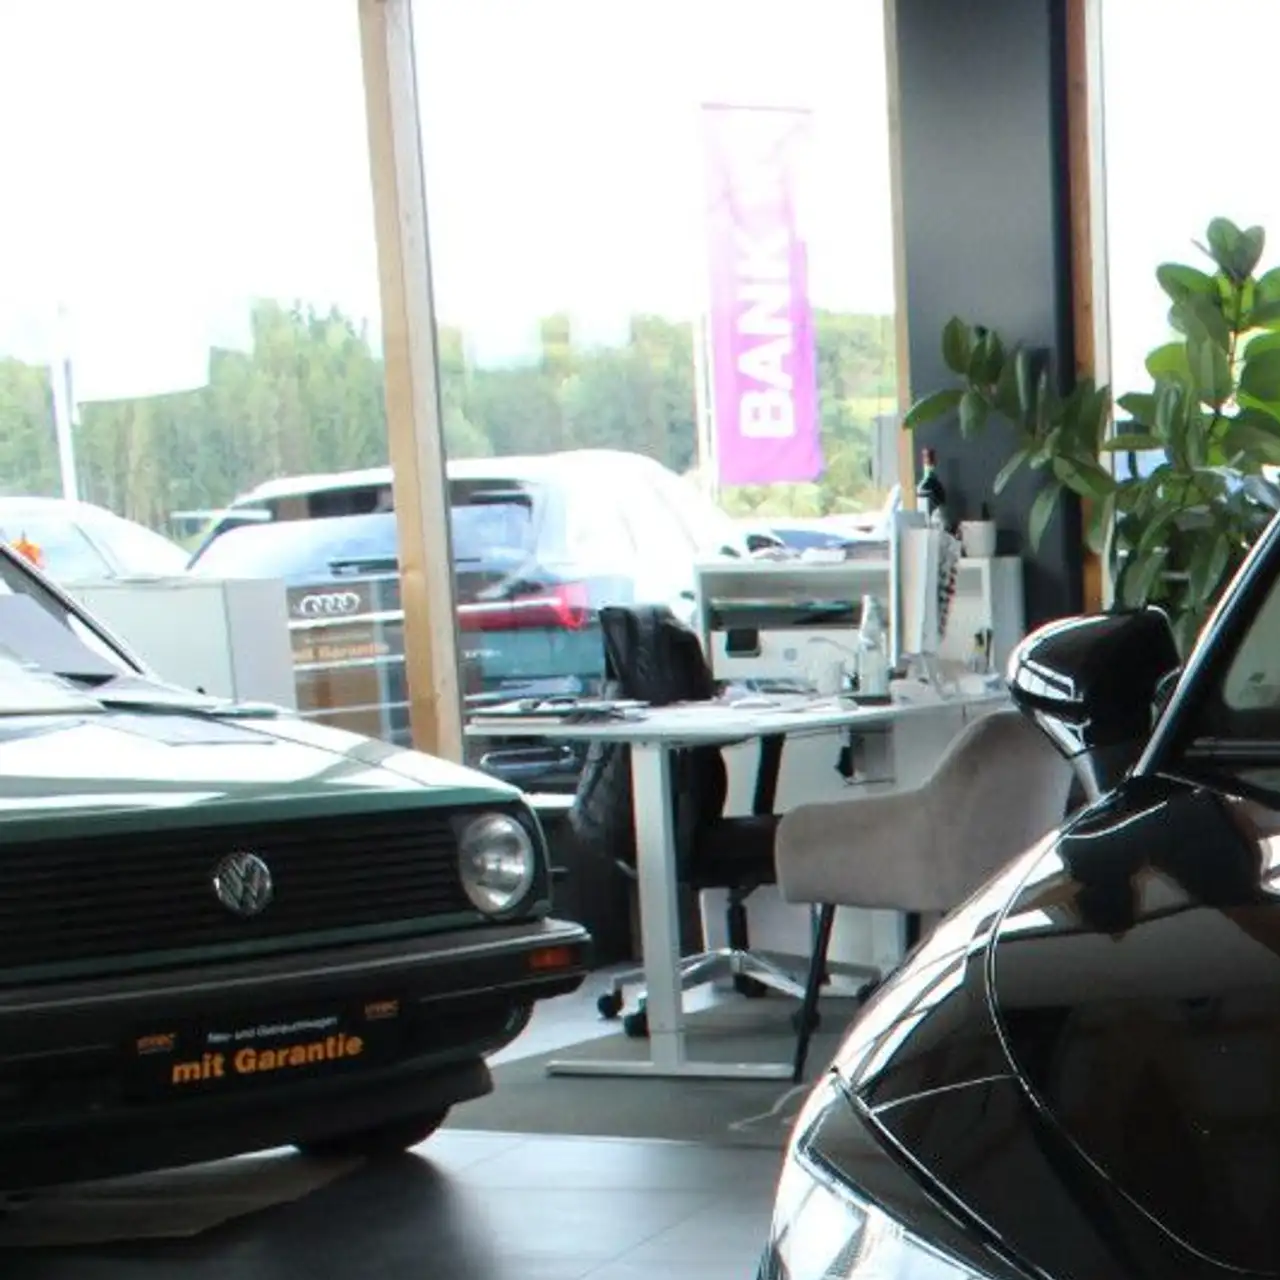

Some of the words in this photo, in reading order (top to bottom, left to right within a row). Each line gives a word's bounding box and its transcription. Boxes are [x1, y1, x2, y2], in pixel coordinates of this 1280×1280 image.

[736, 229, 795, 436] BANK
[172, 1052, 224, 1083] mit
[234, 1033, 363, 1074] Garantie
